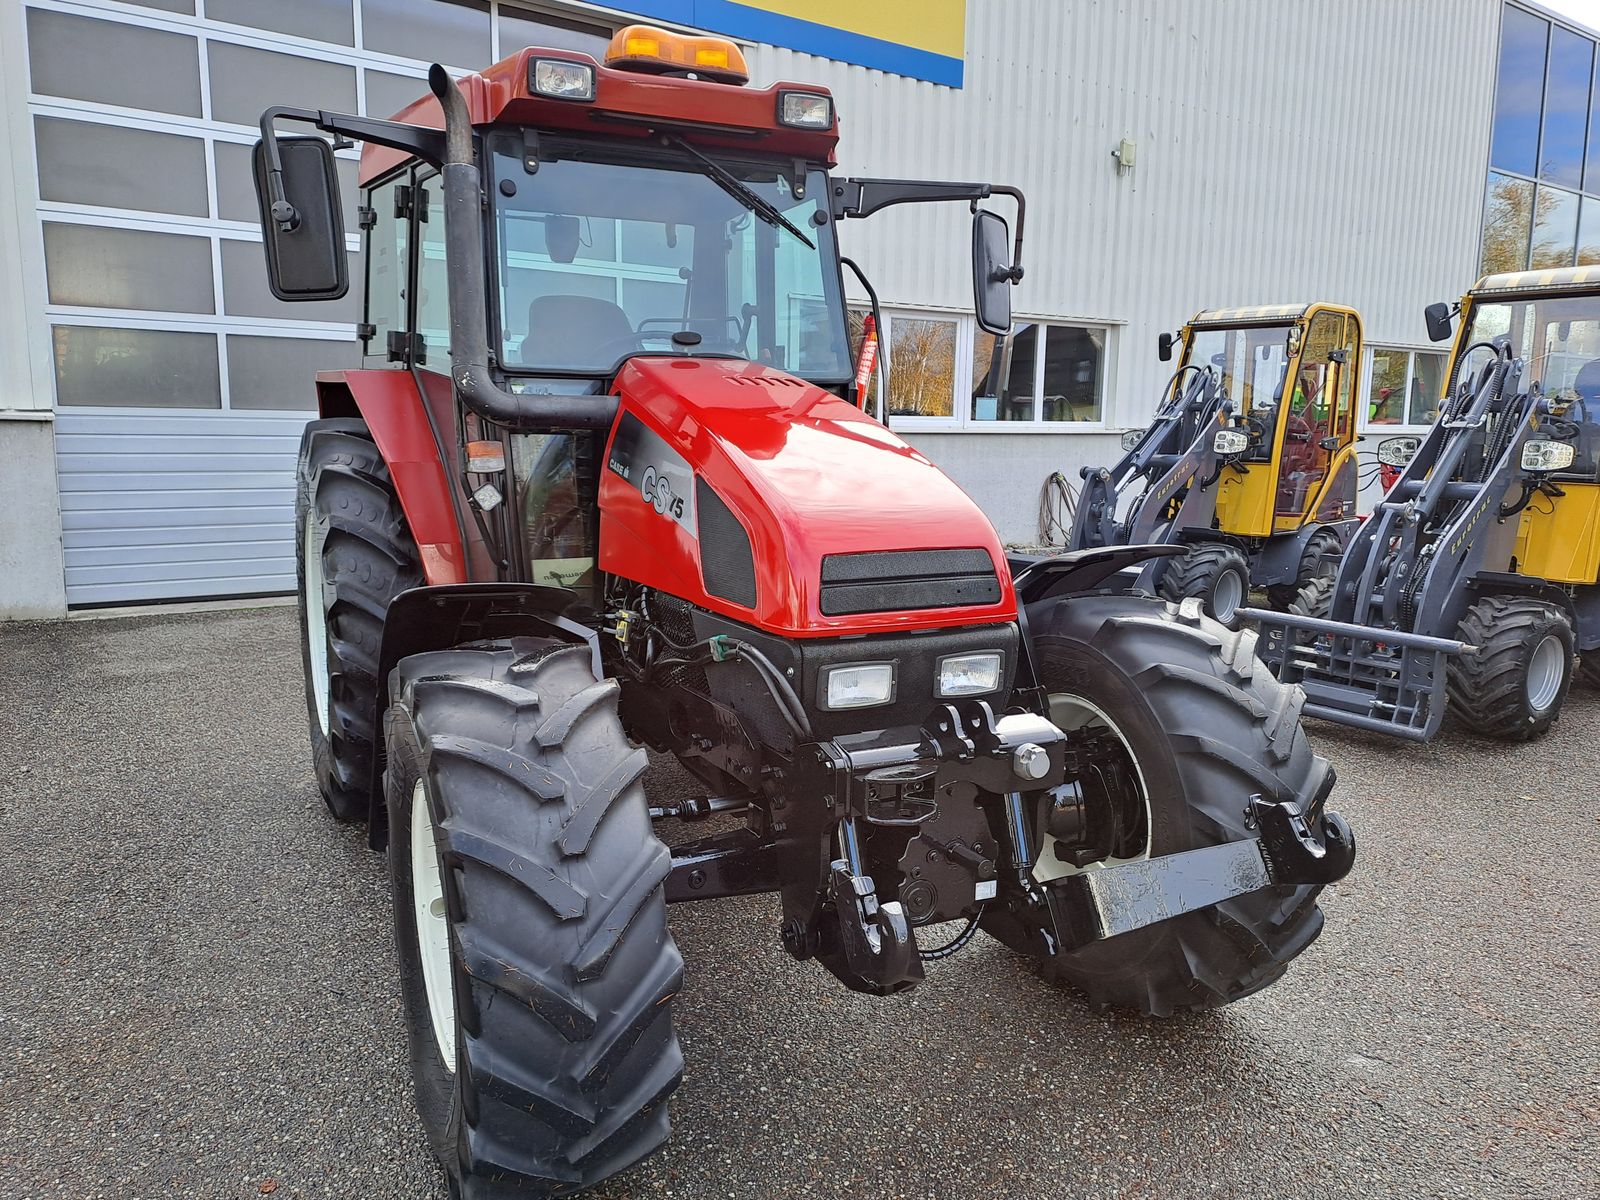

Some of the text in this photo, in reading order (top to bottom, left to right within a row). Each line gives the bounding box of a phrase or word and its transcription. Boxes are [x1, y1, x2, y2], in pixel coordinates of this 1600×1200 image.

[609, 458, 624, 477] CASE
[1157, 462, 1190, 500] Eurotrac
[641, 465, 684, 519] CS 75
[1451, 495, 1491, 555] Eurotrac
